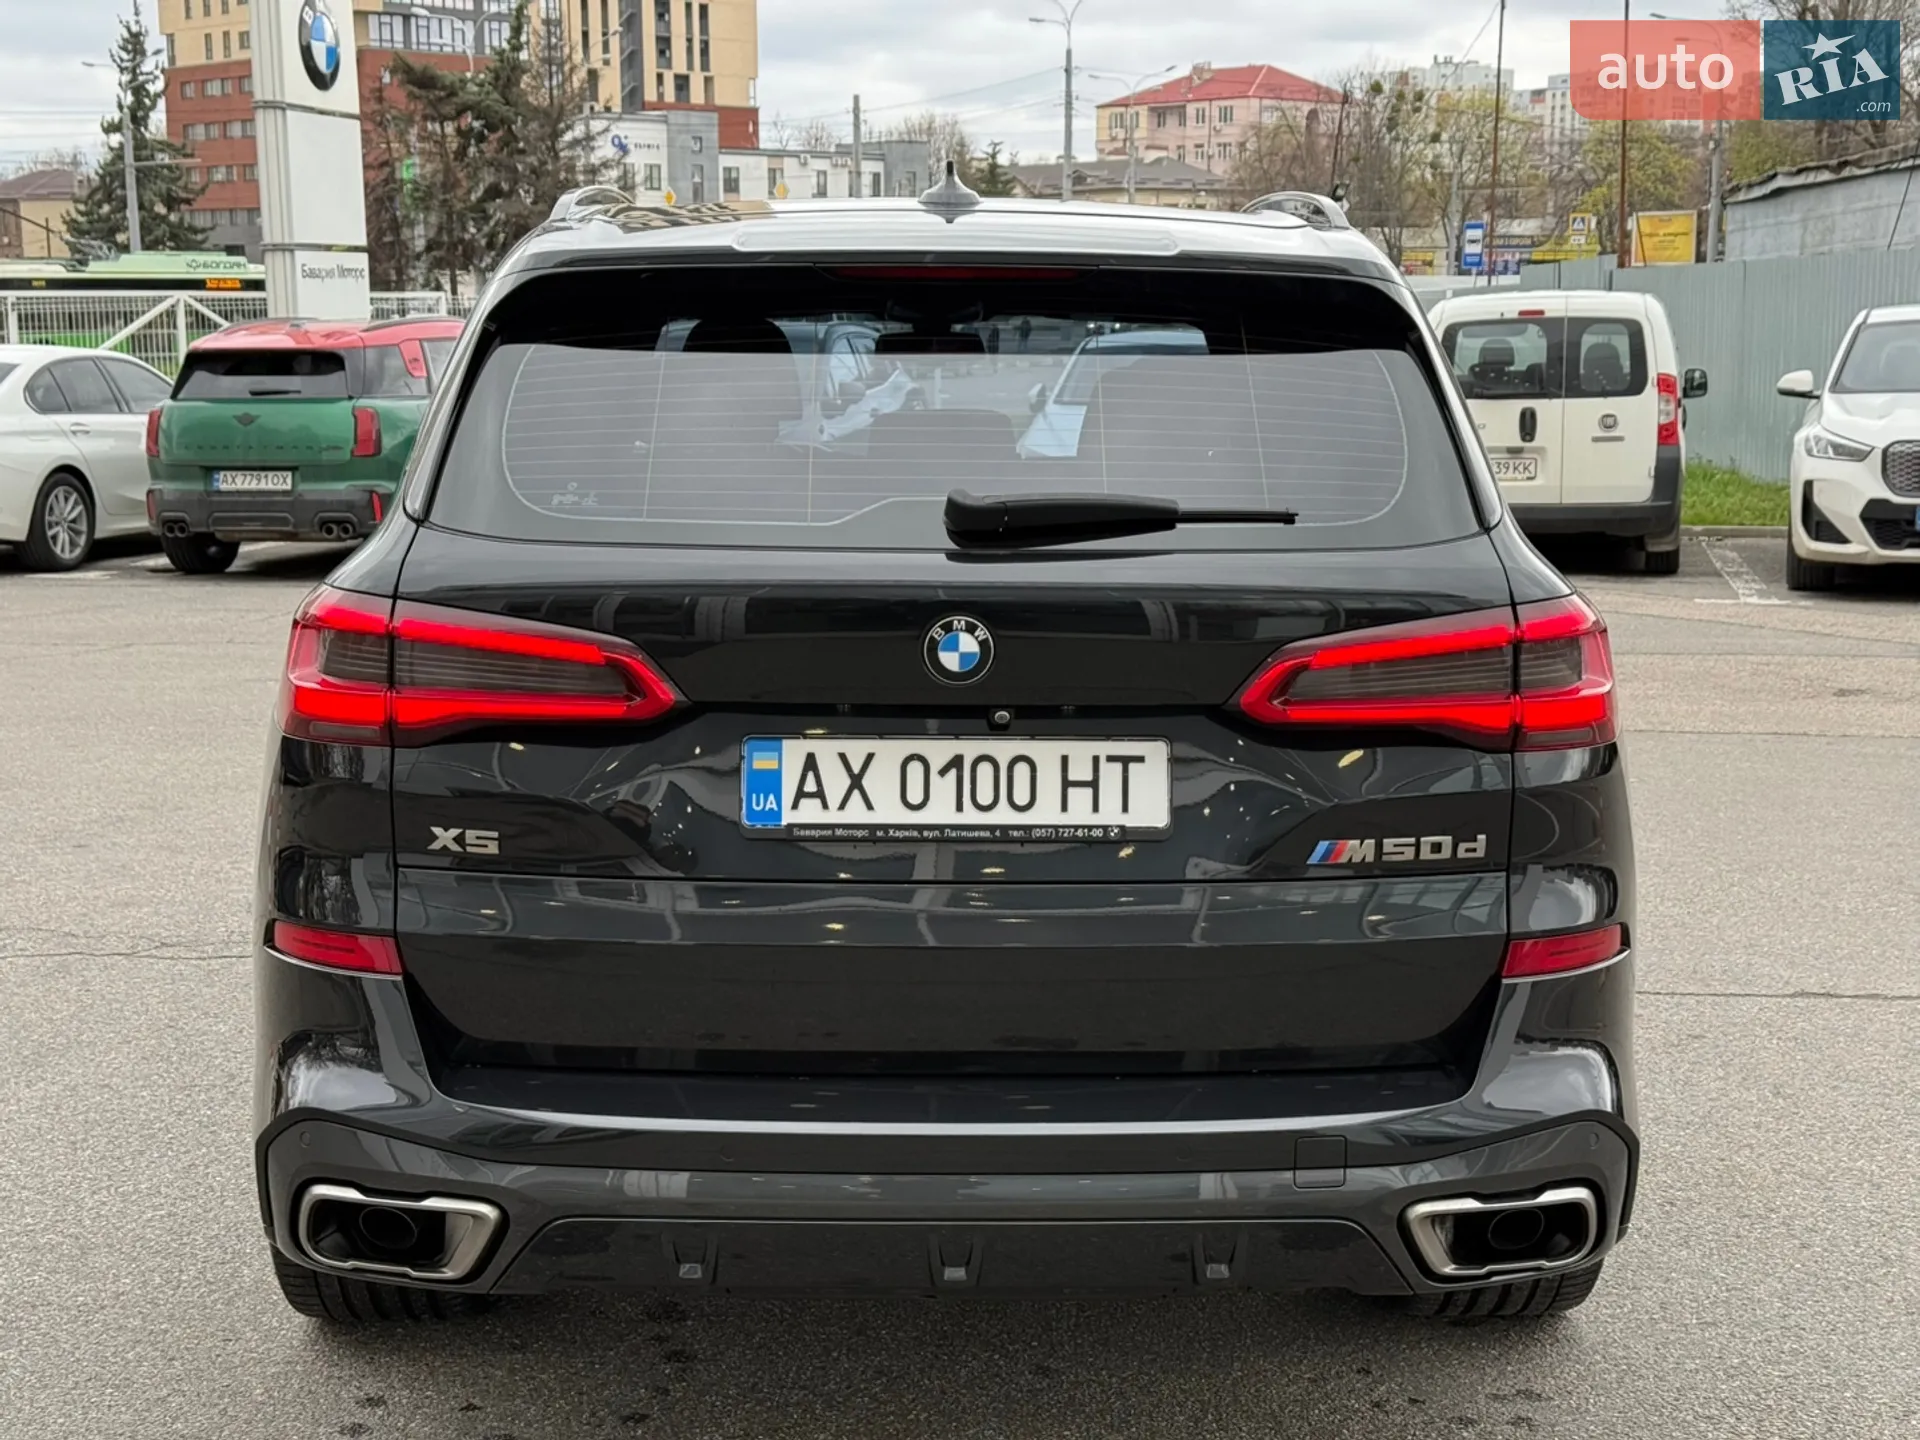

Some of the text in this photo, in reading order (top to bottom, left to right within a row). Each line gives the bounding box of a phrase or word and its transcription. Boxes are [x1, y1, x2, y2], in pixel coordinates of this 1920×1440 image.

[931, 619, 988, 642] BMW
[790, 751, 1146, 814] AX 0100 HT
[752, 793, 778, 812] UA
[426, 826, 500, 855] X5
[834, 827, 870, 838] Моторс
[1031, 828, 1056, 839] (057)
[1058, 828, 1104, 837] 727-61-00
[1341, 834, 1487, 864] M50d
